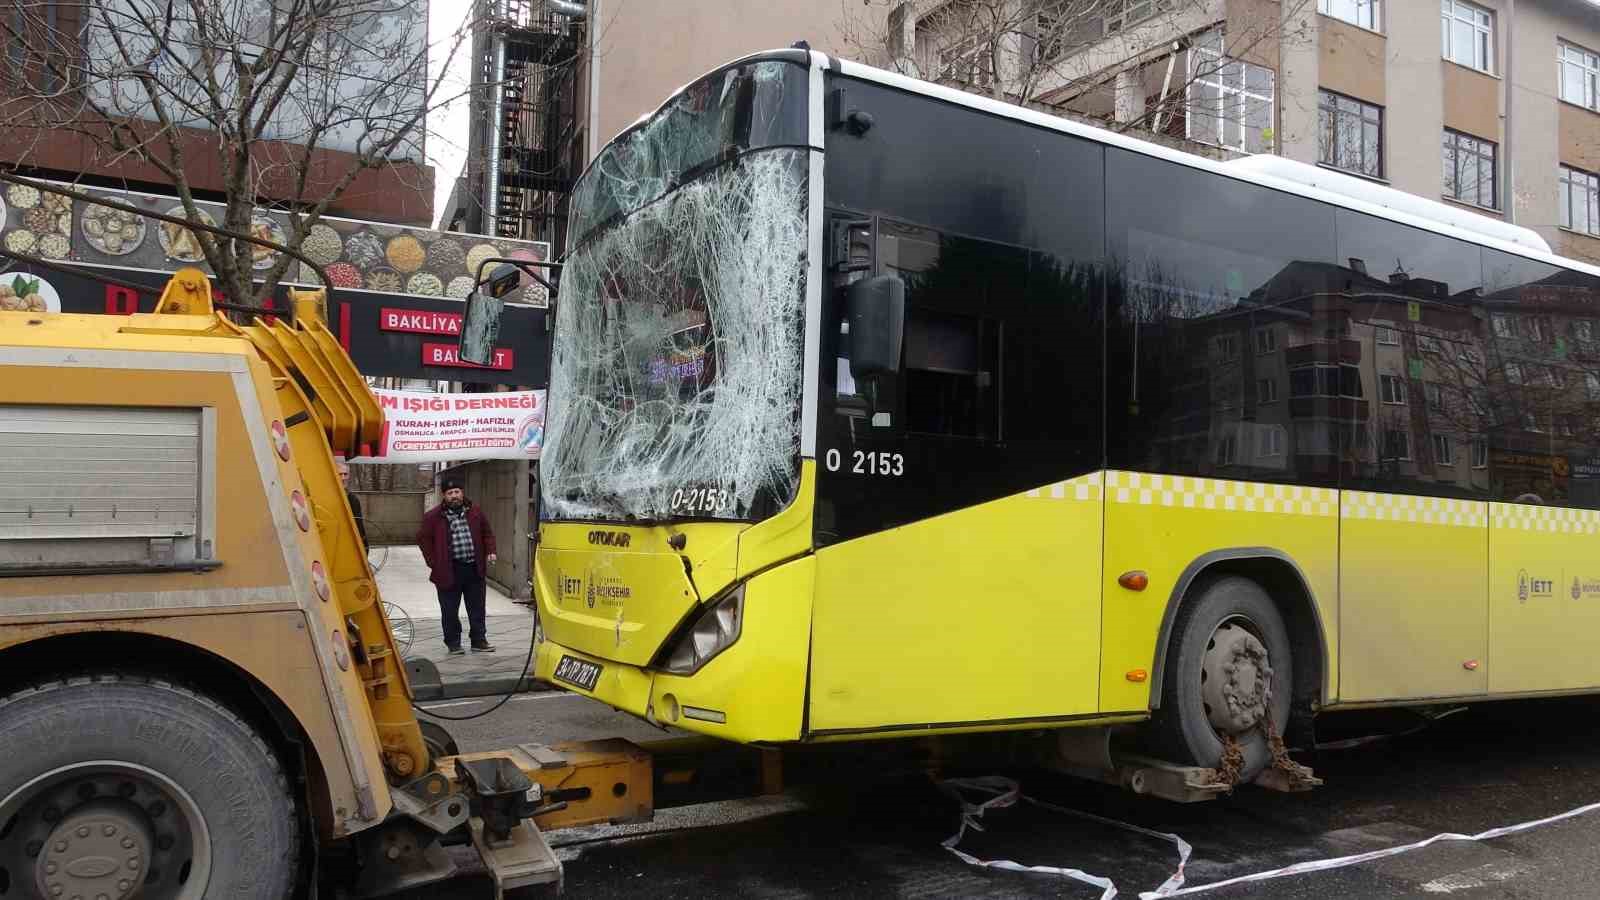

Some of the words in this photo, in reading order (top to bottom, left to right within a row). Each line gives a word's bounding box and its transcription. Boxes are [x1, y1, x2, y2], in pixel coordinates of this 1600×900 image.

[388, 314, 463, 332] BAKLİYA
[404, 398, 450, 412] IŞIĞI
[455, 394, 536, 410] DERNEĞİ
[396, 419, 438, 428] KURAN-I
[440, 418, 469, 428] KERİM
[476, 417, 515, 425] HAFIZLIK
[853, 450, 904, 476] 2153
[588, 531, 631, 547] OTOKAR
[564, 575, 581, 594] İETT
[1531, 576, 1552, 592] İETT
